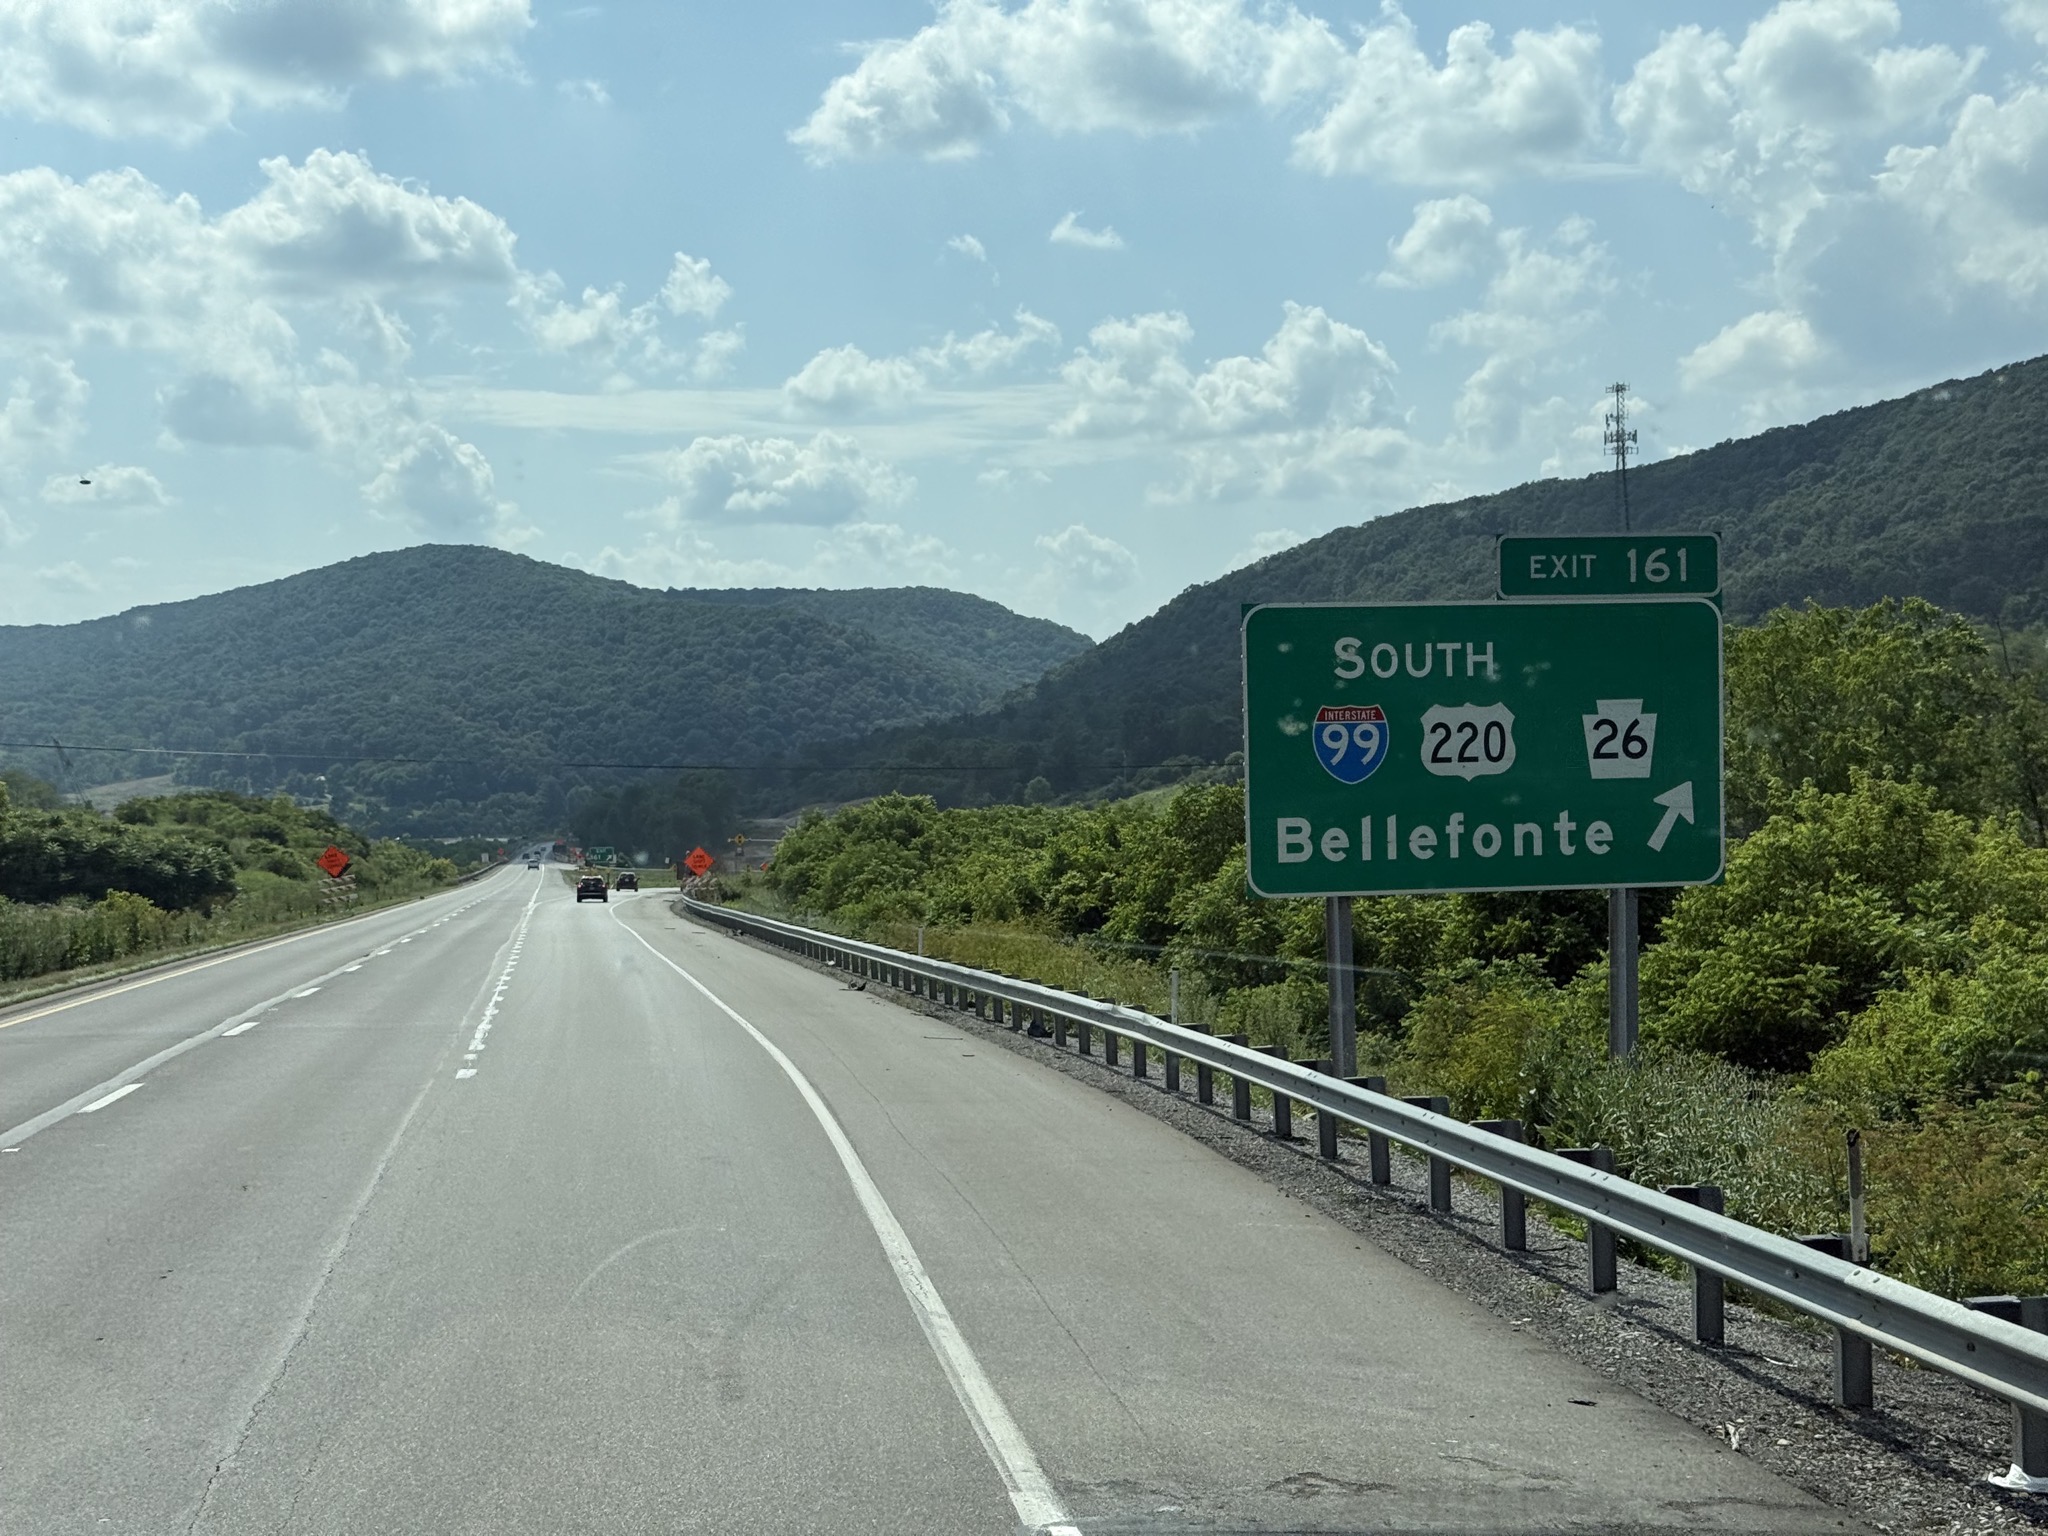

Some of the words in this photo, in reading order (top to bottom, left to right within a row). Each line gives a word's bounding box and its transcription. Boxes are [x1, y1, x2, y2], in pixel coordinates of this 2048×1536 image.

[1530, 554, 1596, 579] EXIT
[1627, 548, 1688, 583] 161
[1333, 637, 1494, 680] SOUTH
[1324, 708, 1377, 721] INTERSTATE
[1322, 724, 1380, 766] 99
[1430, 721, 1506, 764] 220
[1592, 718, 1648, 760] 26
[1277, 810, 1614, 864] Bellefonte
